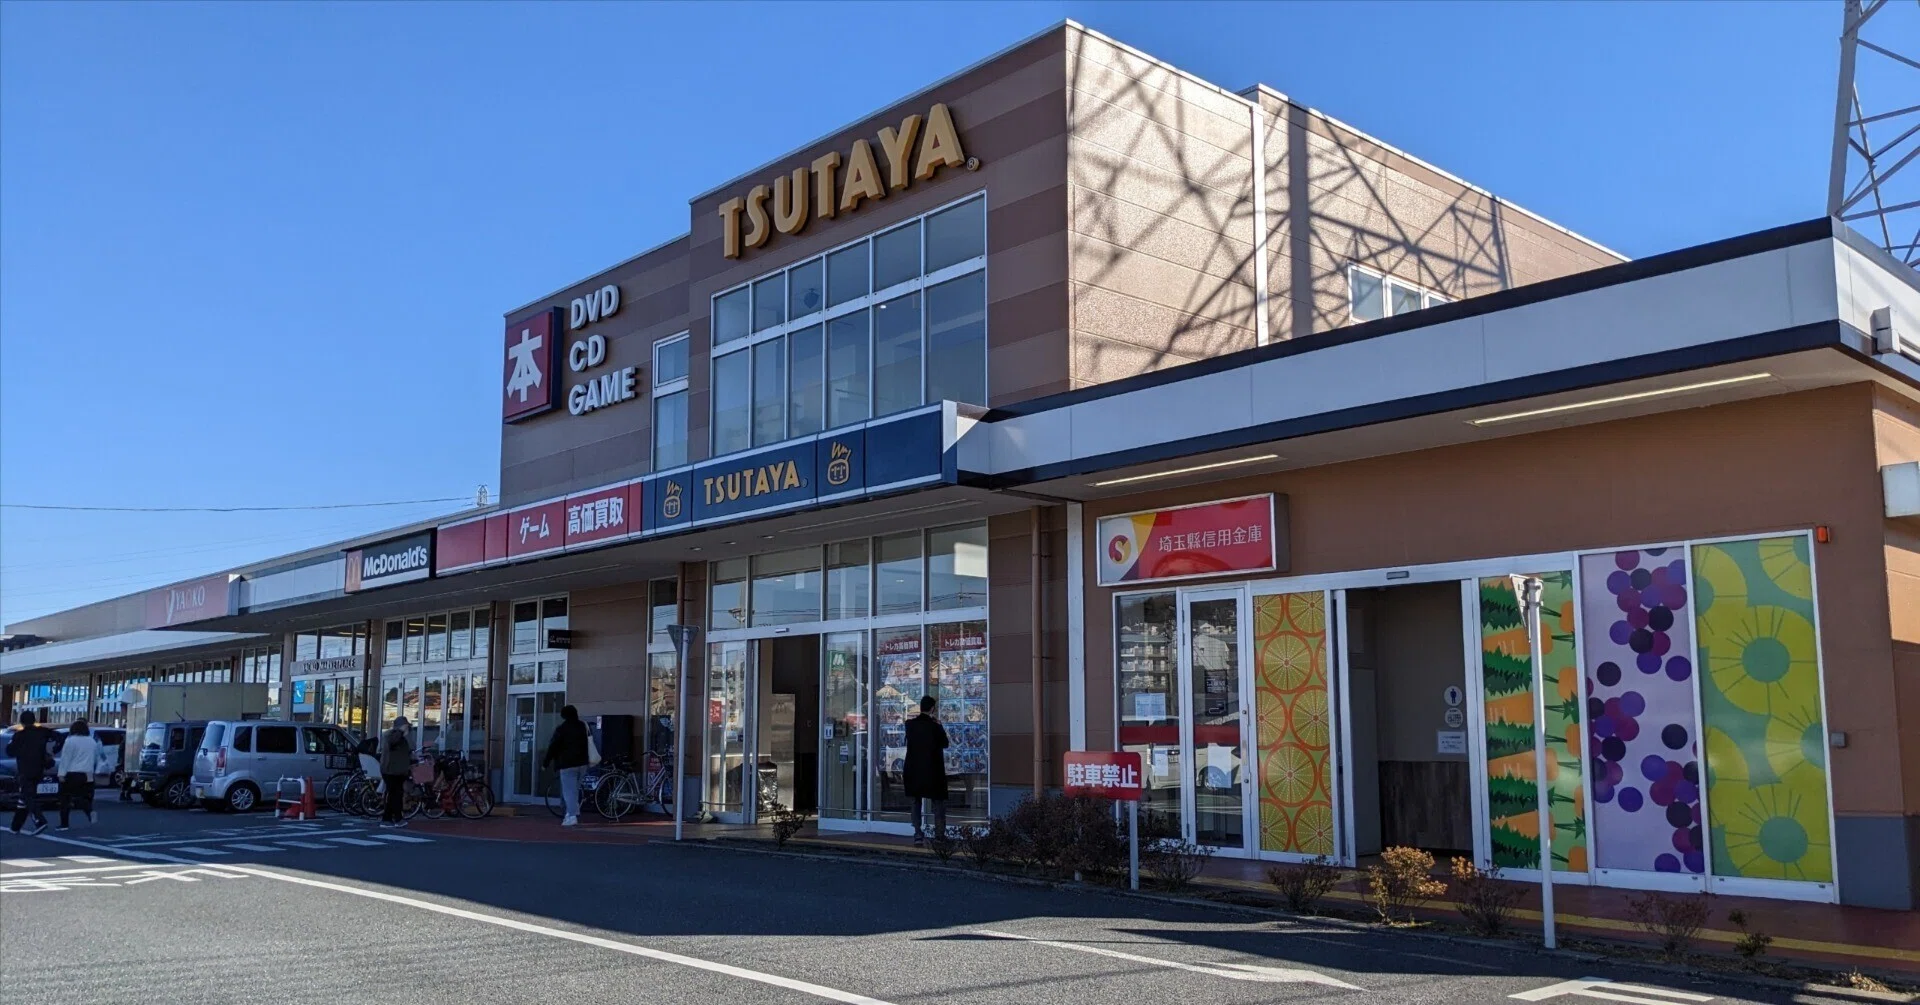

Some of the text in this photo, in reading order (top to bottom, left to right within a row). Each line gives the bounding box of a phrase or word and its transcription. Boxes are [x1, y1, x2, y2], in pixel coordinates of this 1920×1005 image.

[570, 284, 620, 330] DVD
[506, 328, 543, 403] 本
[569, 334, 607, 372] CD
[568, 366, 637, 416] GAME
[519, 496, 624, 545] ゲーム 高価買取
[1158, 524, 1263, 553] 埼玉縣信用金庫
[363, 545, 428, 578] McDonald's
[175, 584, 206, 611] YAOKO
[1067, 763, 1139, 788] 駐車禁止
